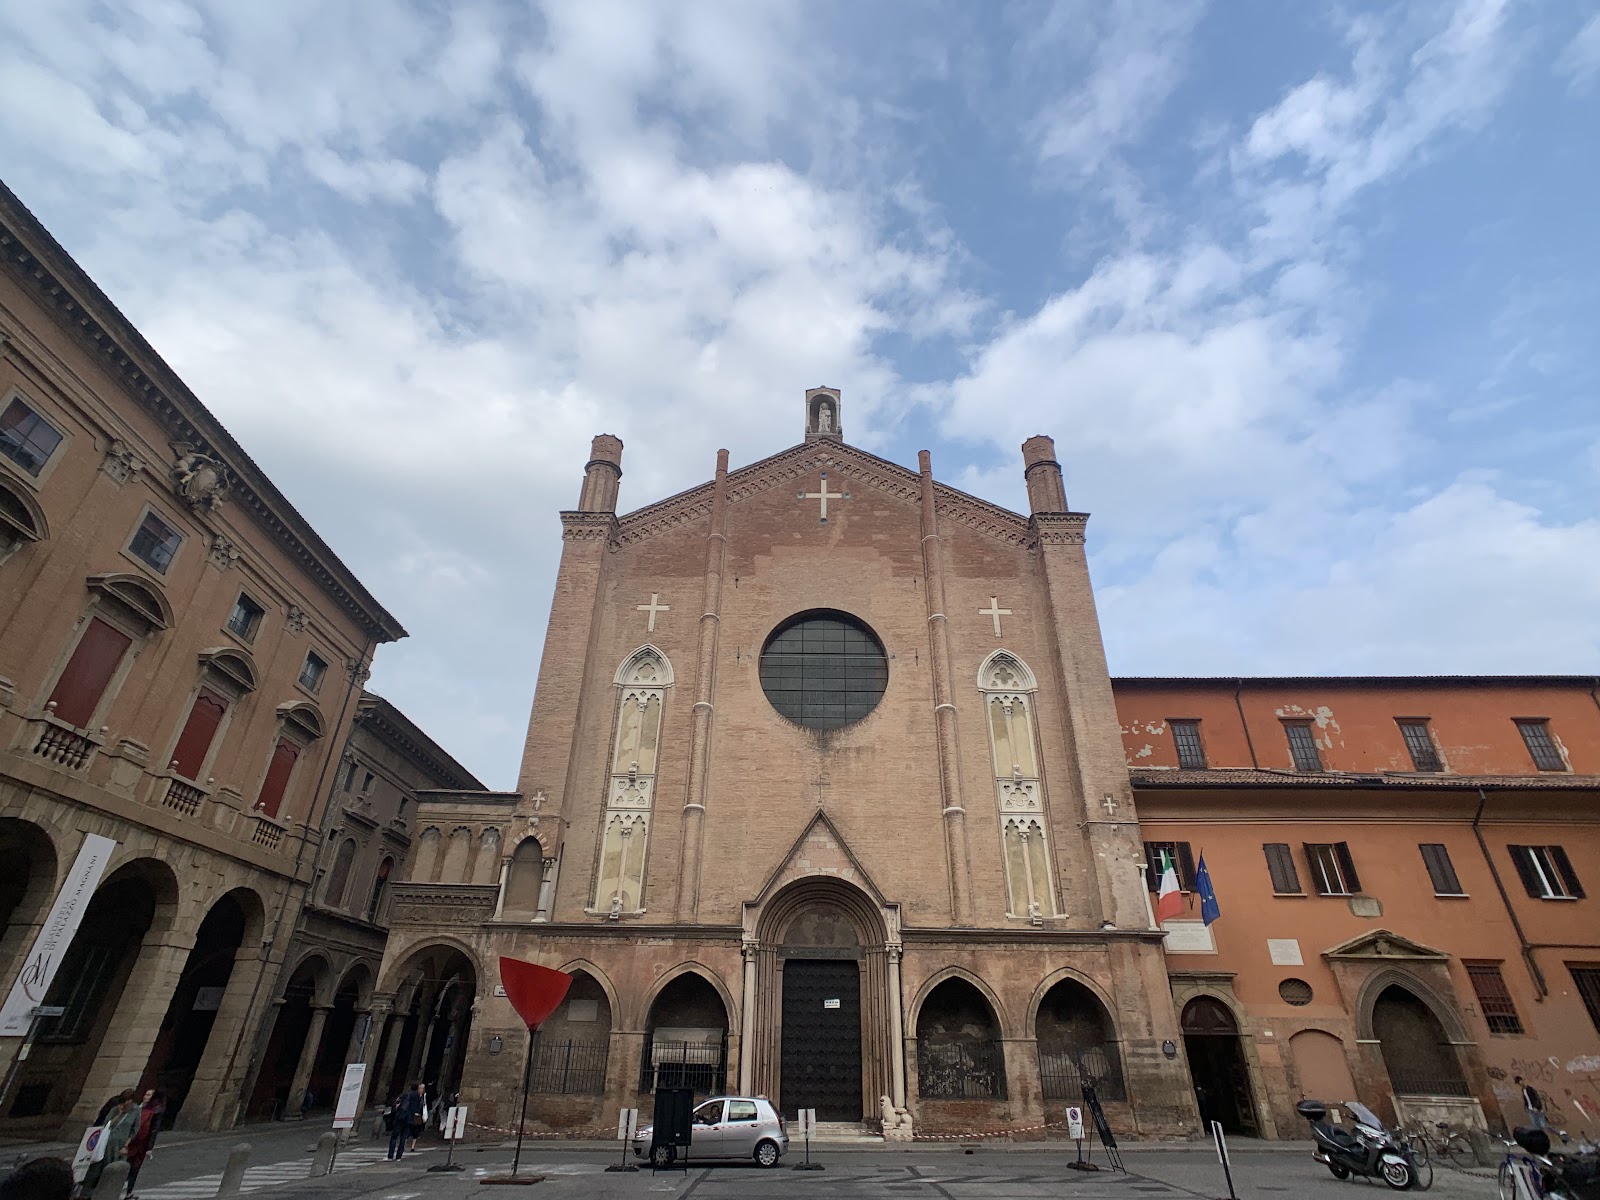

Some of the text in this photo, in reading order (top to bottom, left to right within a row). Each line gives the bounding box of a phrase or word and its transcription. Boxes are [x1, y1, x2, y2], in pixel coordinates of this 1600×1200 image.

[48, 855, 98, 951] DI PALAZZO MAGNANI
